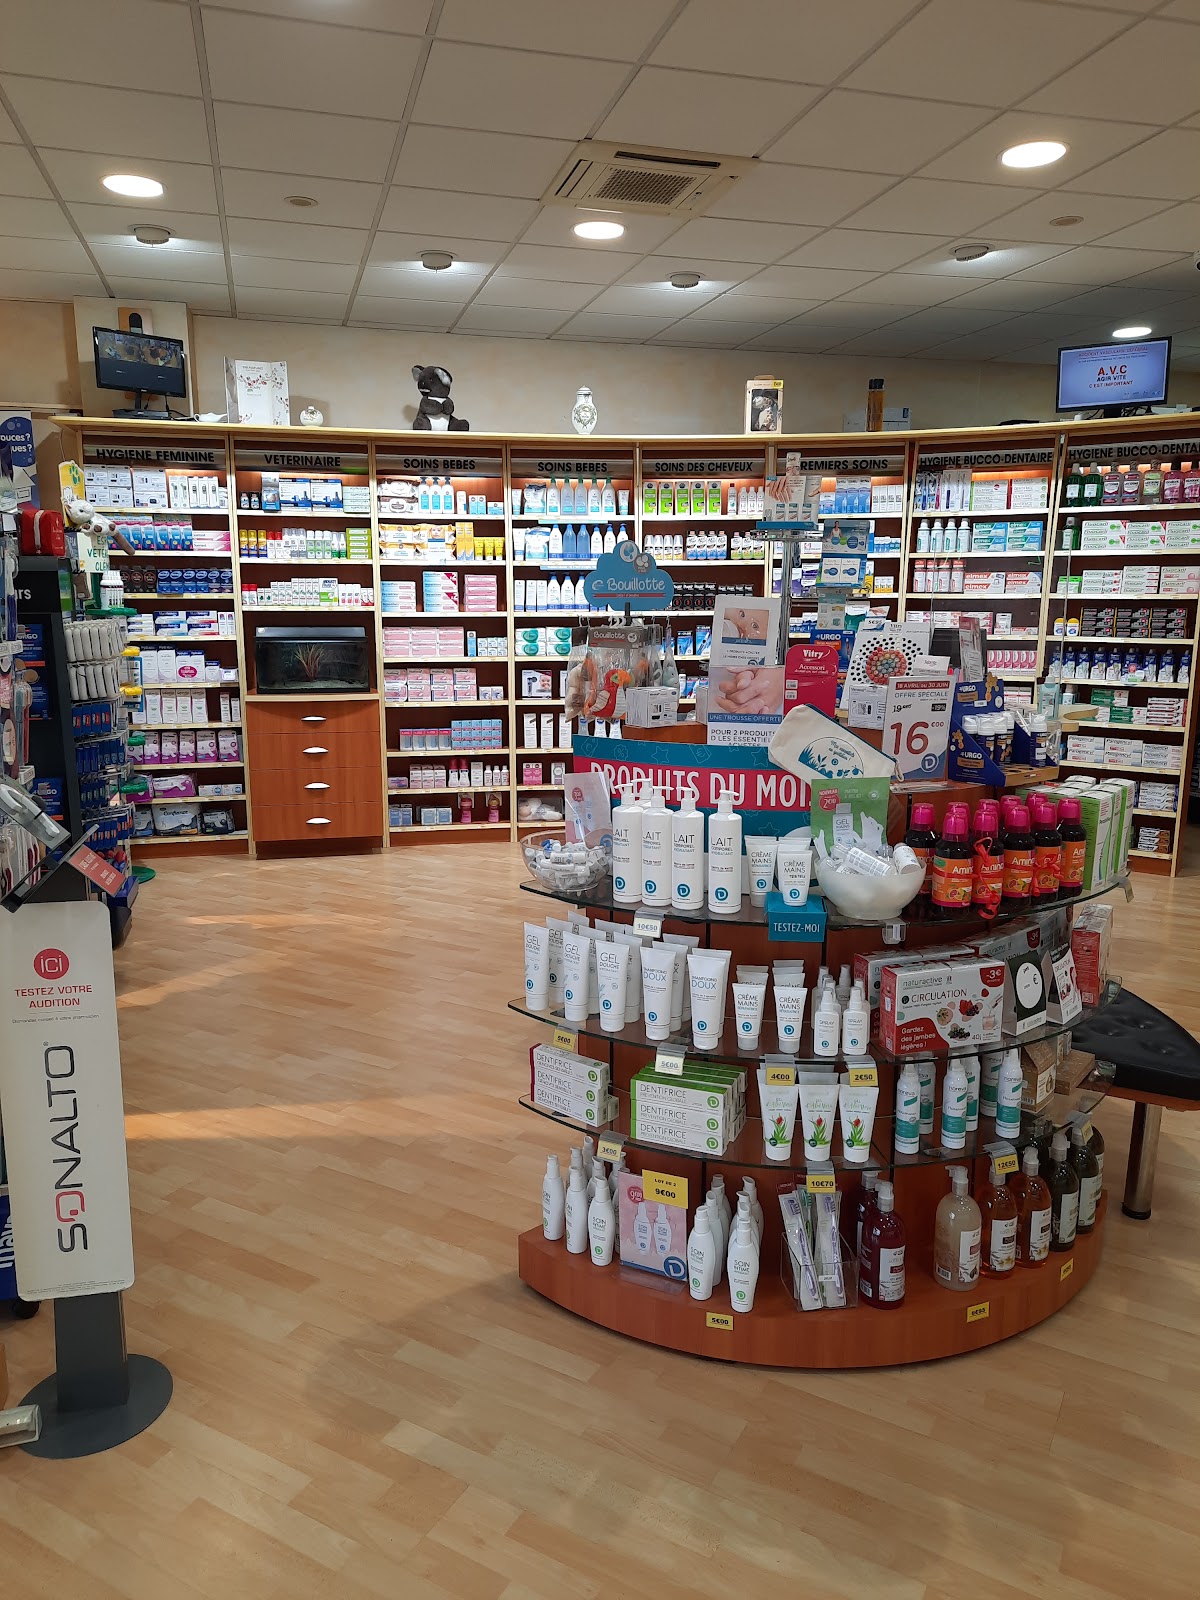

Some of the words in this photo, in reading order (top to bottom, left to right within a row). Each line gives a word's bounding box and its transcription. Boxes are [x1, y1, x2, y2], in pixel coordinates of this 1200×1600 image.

[96, 448, 153, 462] HYGIENE
[155, 450, 215, 463] FEMININE
[920, 456, 962, 467] HYGIENE
[964, 452, 1052, 465] BUCCO-DENTAIRE
[1069, 448, 1112, 460] HYGIENE
[264, 454, 341, 467] VETERINAIRE
[404, 458, 439, 469] SOINS
[442, 459, 476, 470] BEBES
[800, 460, 848, 470] REMIERS
[853, 459, 888, 469] SOINS
[537, 462, 572, 472] SOINS
[575, 462, 608, 473] BEBES
[655, 462, 685, 472] SOINS
[687, 462, 704, 472] DES
[707, 462, 753, 472] CHEVEUX
[607, 577, 665, 590] Bouillotte
[803, 650, 824, 659] Vitry
[890, 722, 929, 755] 16
[710, 774, 745, 806] DU
[674, 834, 695, 844] LAIT
[711, 837, 733, 846] LAIT
[774, 923, 820, 933] TESTEZ-MOI
[548, 928, 563, 940] GEL
[526, 934, 540, 946] GEL
[565, 944, 580, 956] GEL
[600, 952, 620, 964] GEL
[644, 972, 667, 981] DOUX
[986, 969, 1002, 979] -3€
[692, 980, 717, 990] DOUX
[903, 976, 942, 987] naturactive
[14, 987, 54, 997] TESTEZ
[58, 985, 92, 994] VOTRE
[911, 988, 967, 1003] CIRCULATION
[737, 993, 758, 1001] CRÈME
[779, 996, 800, 1004] CRÈME
[29, 998, 80, 1008] AUDITION
[902, 1026, 924, 1034] Gardez
[558, 1036, 571, 1044] 5€00
[913, 1032, 936, 1042] jambes
[900, 1042, 923, 1051] légères
[536, 1053, 573, 1070] DENTIFRICE
[538, 1071, 572, 1089] DENTIFRICE
[640, 1084, 687, 1098] DENTIFRICE
[538, 1089, 571, 1107] DENTIFRICE
[640, 1104, 687, 1120] DENTIFRICE
[640, 1123, 687, 1139] DENTIFRICE
[44, 1045, 88, 1252] SONALTO
[602, 1147, 617, 1155] 3€00
[998, 1160, 1016, 1168] 12€50
[655, 1189, 676, 1198] 9€00
[592, 1217, 606, 1225] SOIN
[691, 1247, 704, 1256] SOIN
